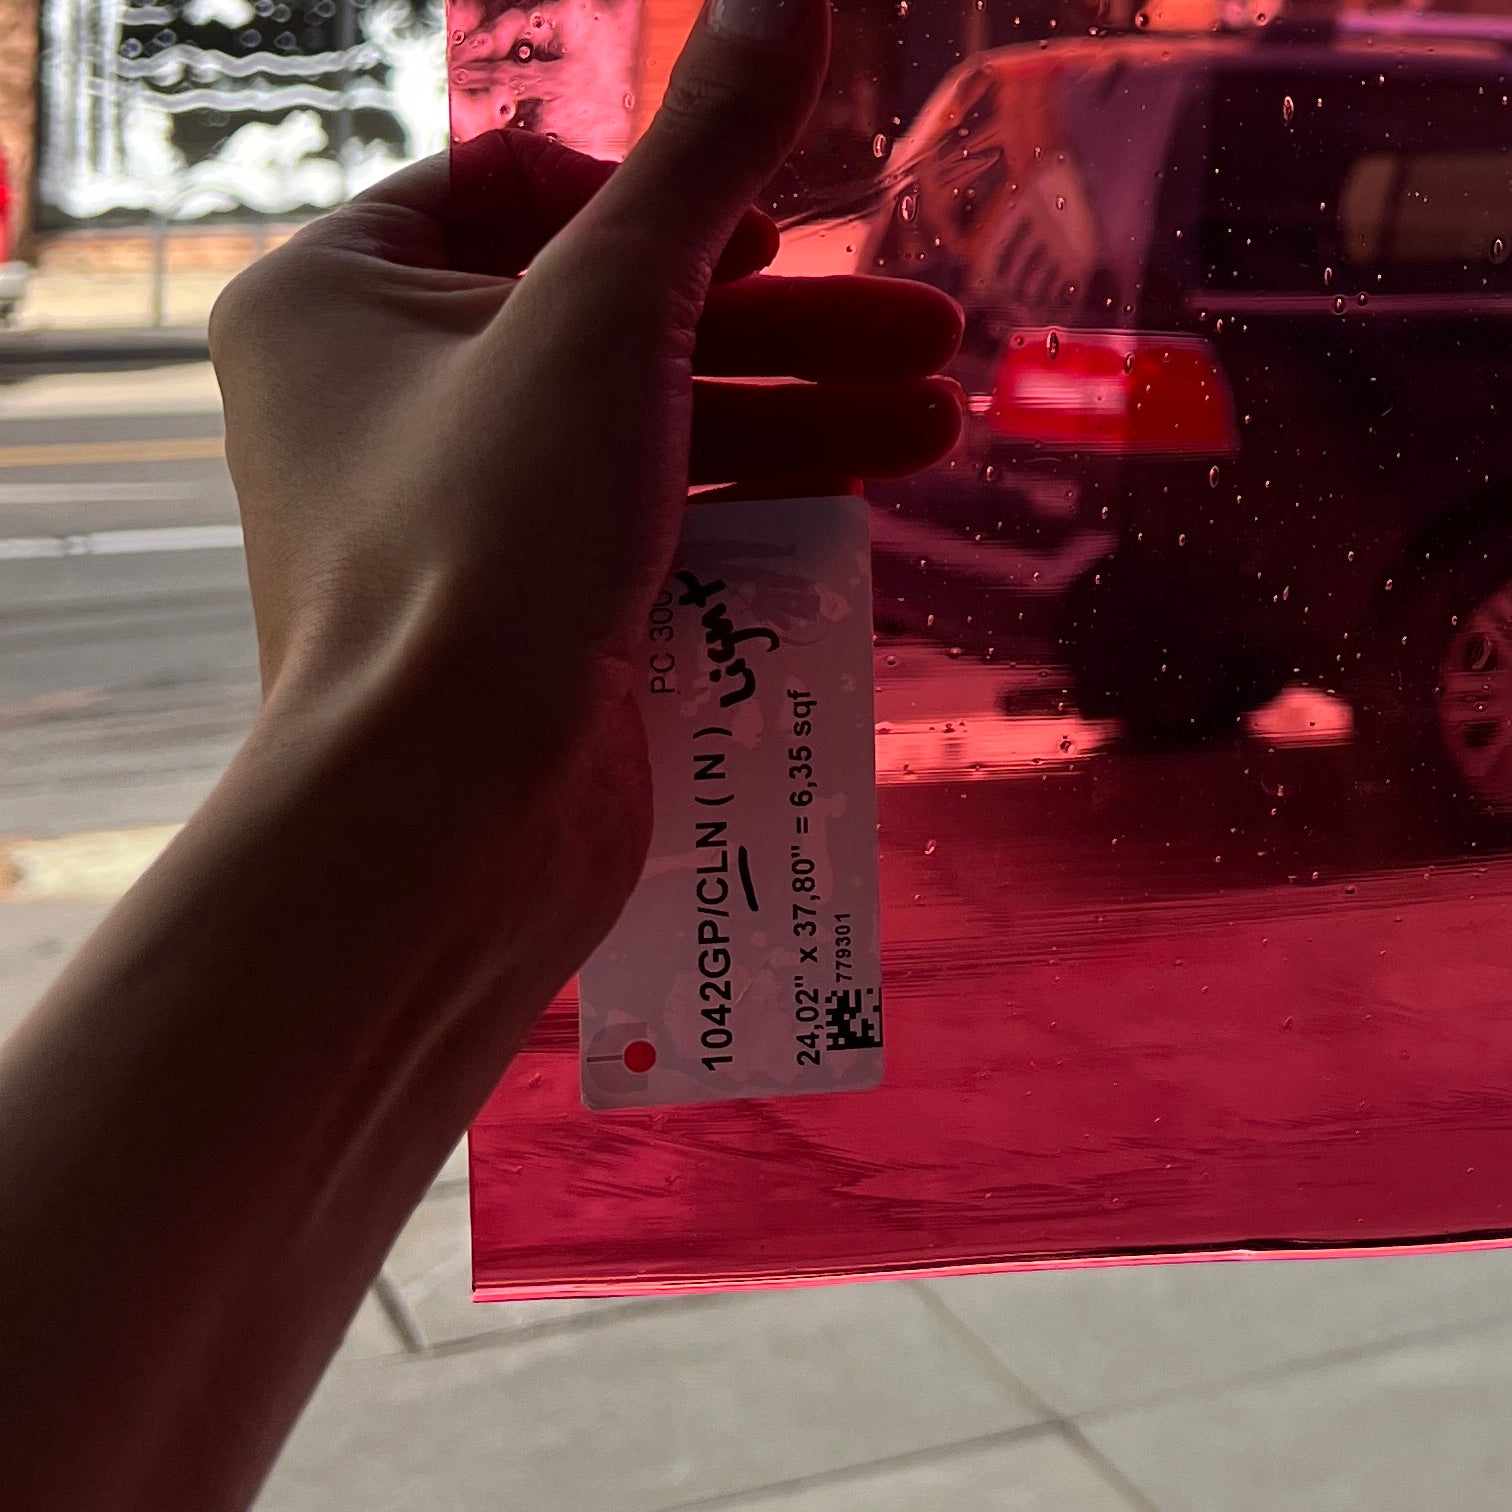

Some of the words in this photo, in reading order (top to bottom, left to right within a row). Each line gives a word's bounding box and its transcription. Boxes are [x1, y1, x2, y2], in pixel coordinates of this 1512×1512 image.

[650, 653, 676, 694] PC
[787, 688, 817, 737] sqf
[788, 745, 818, 807] 6,35
[796, 816, 808, 834] =
[790, 845, 821, 936] 37,80"
[696, 821, 733, 1071] 1042GP/CLN
[800, 945, 818, 963] x
[834, 913, 852, 982] 779301
[795, 975, 824, 1066] 24,02"
